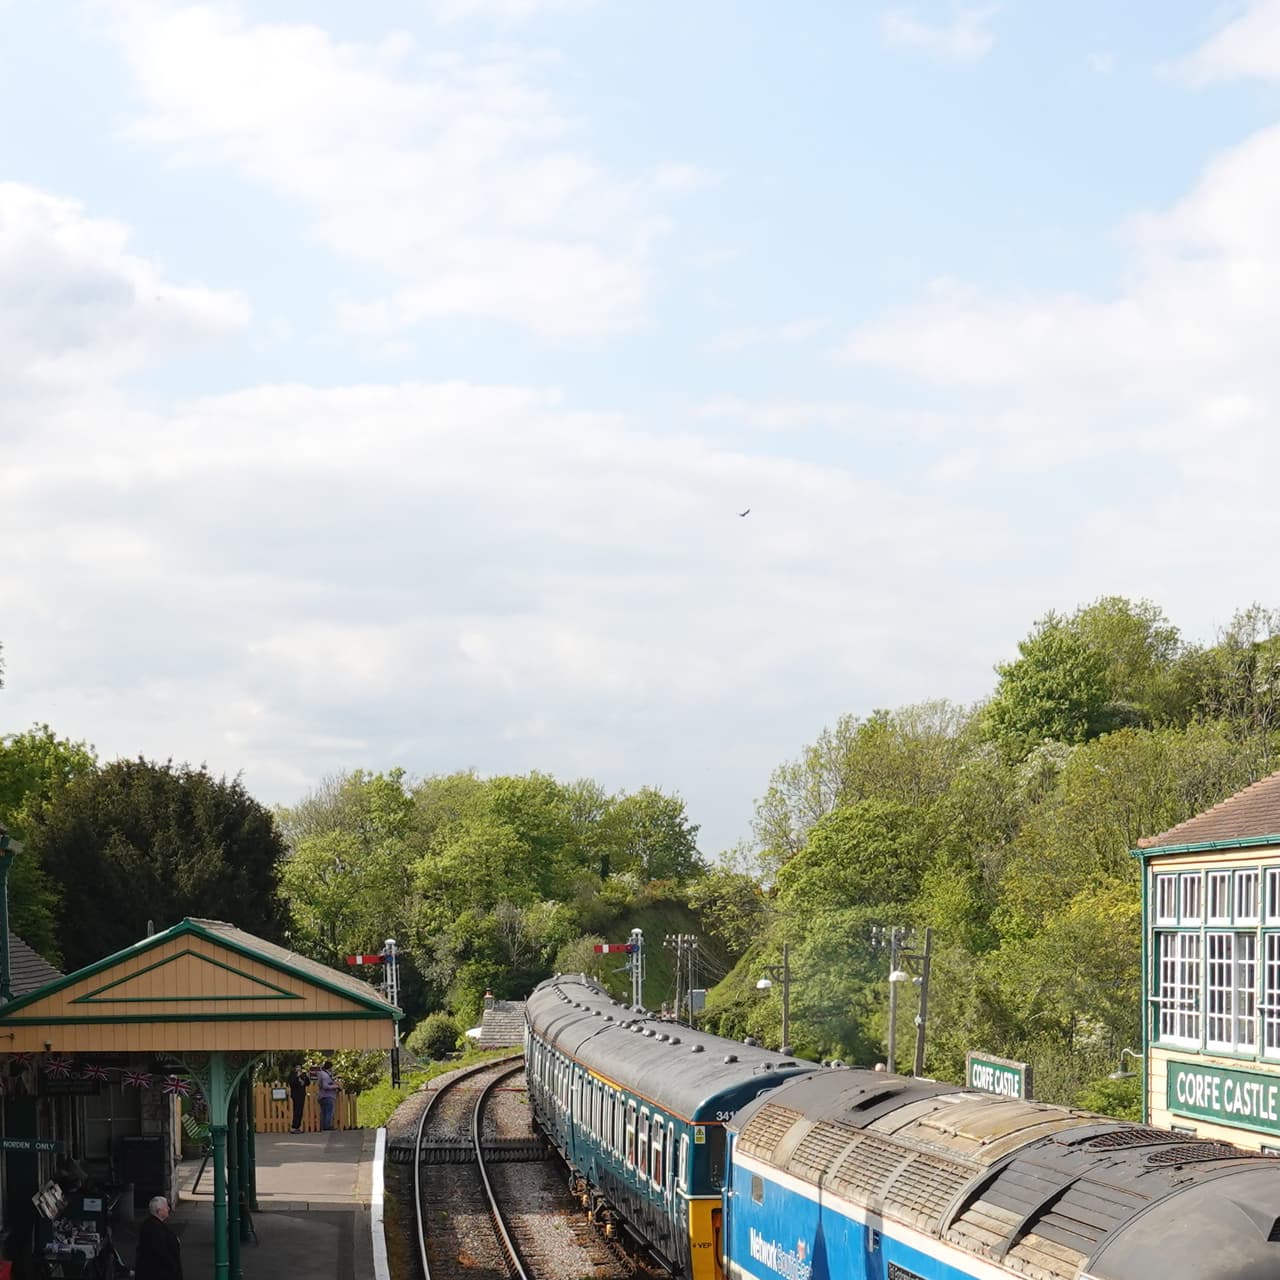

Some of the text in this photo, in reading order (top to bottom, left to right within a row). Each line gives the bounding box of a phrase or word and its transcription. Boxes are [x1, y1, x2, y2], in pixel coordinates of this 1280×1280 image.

[972, 1063, 1020, 1098] CORFE CASTLE
[1176, 1071, 1279, 1121] CORFE CASTLE
[716, 1111, 736, 1121] 341
[3, 1140, 56, 1151] NORDEN ONLY
